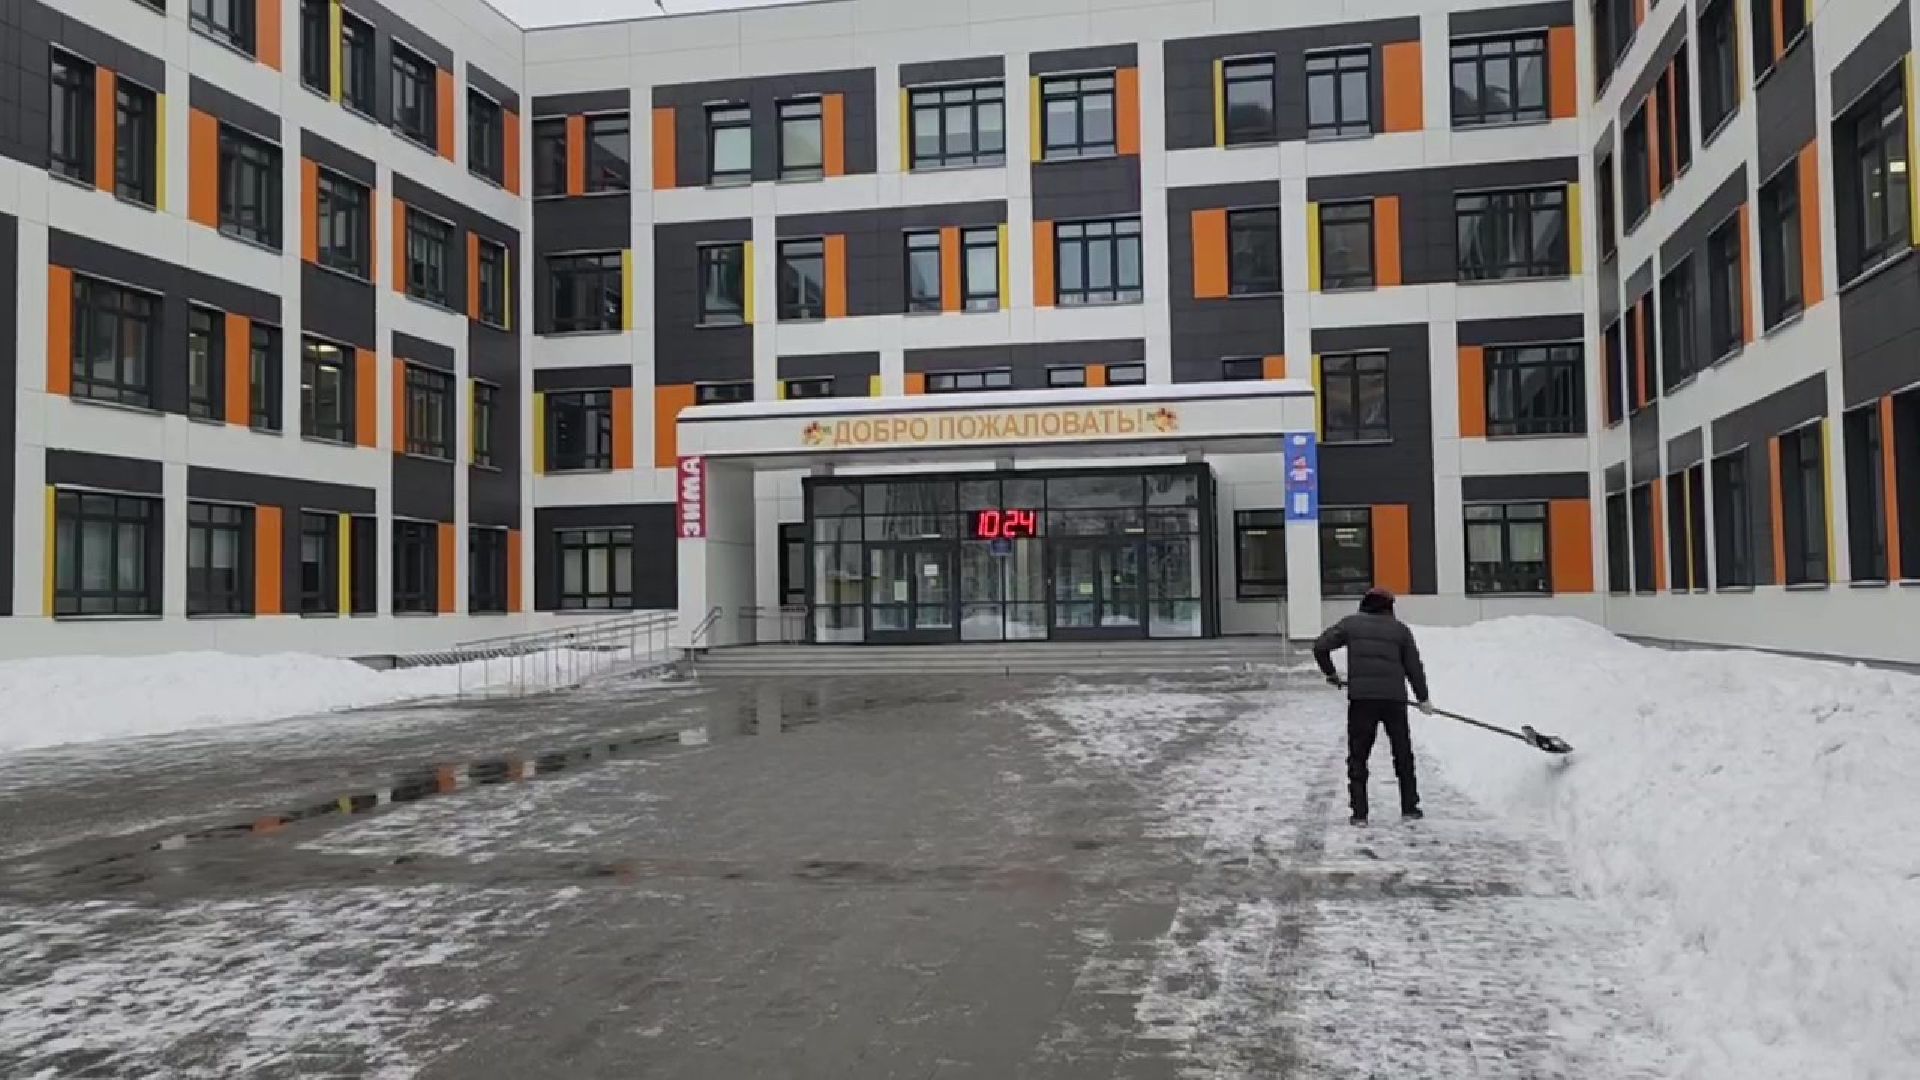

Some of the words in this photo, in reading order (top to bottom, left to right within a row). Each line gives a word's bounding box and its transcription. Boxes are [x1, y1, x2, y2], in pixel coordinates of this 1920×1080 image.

[834, 418, 928, 445] ДОБРО
[938, 408, 1144, 440] ПОЖАЛОВАТЬ!
[681, 456, 701, 536] ЗИМА
